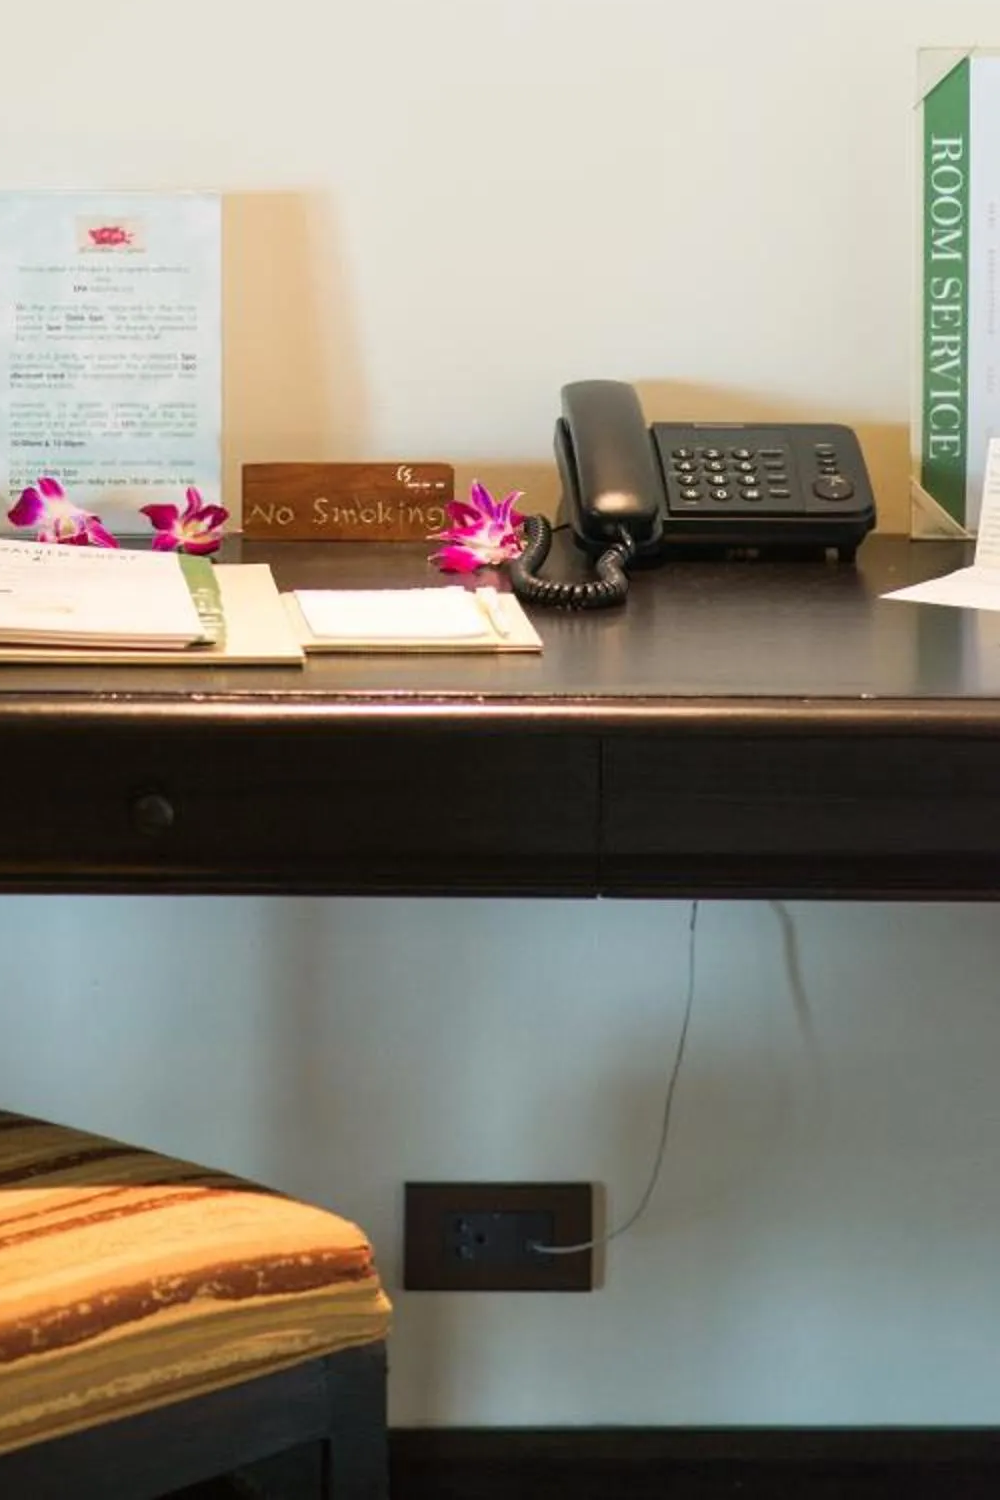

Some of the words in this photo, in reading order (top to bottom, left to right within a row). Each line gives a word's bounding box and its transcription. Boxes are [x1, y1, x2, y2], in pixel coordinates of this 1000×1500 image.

[930, 134, 963, 261] ROOM
[929, 276, 962, 459] SERVICE
[312, 497, 445, 531] Smoking
